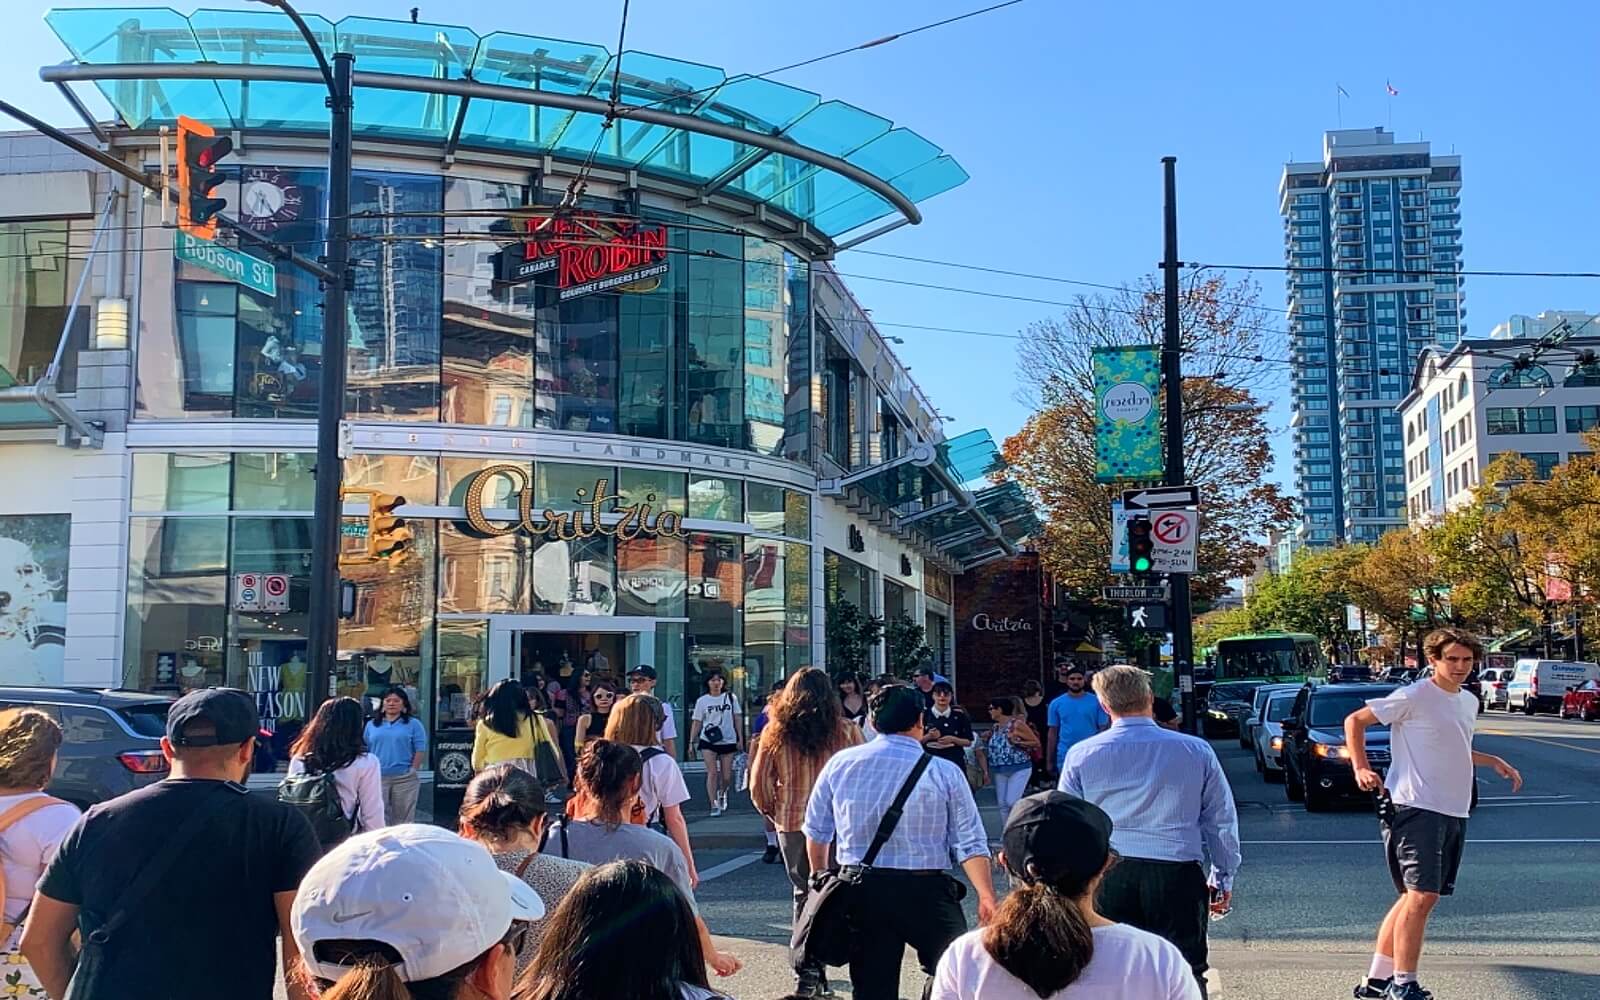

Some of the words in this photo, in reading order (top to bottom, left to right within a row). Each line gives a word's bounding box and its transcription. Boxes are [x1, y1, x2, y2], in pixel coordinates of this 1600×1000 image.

[184, 233, 245, 277] Robson
[252, 262, 269, 287] St
[519, 259, 556, 275] CANADA'S
[559, 224, 668, 288] ROBIN
[560, 282, 598, 299] GOURMET
[599, 273, 633, 289] BURGERS
[640, 264, 668, 279] SPIRITS
[573, 443, 750, 470] LANDMARK
[248, 666, 281, 692] NEW
[249, 692, 306, 718] EASON
